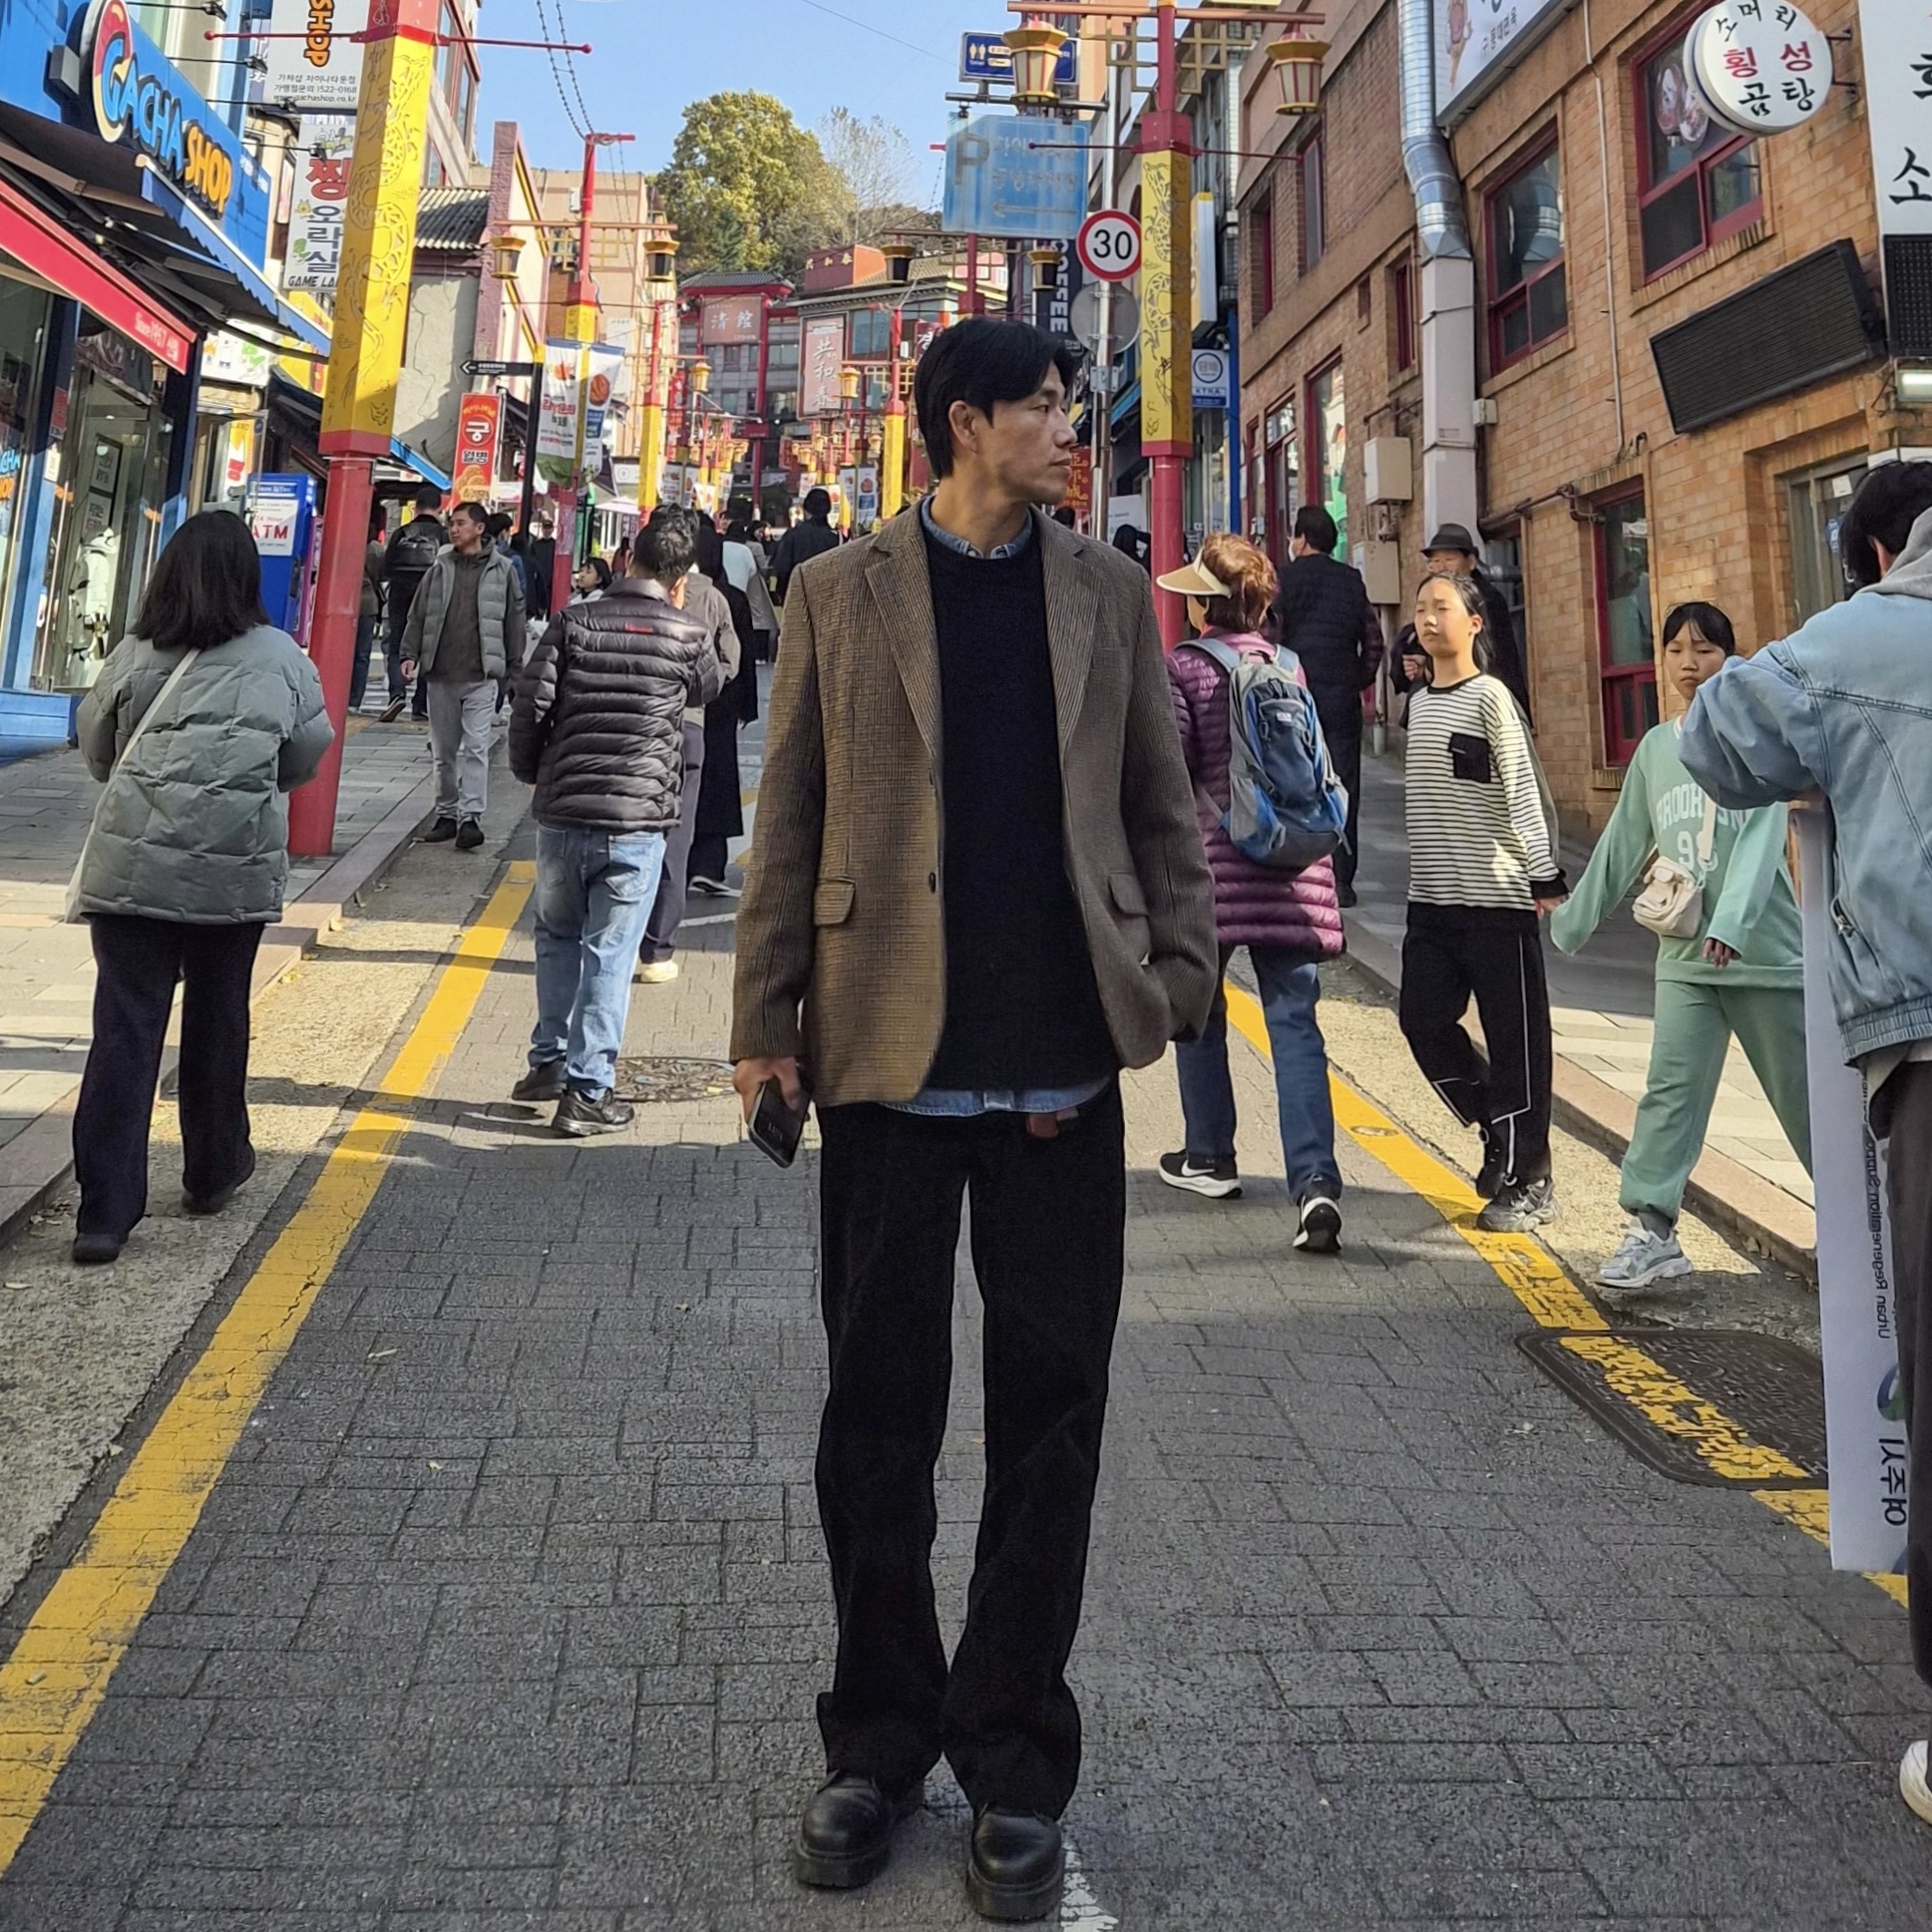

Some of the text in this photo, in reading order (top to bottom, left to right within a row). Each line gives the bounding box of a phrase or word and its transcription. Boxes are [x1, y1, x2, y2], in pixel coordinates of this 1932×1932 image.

[1716, 0, 1797, 42] 소머리
[1723, 41, 1813, 78] 횡성
[1738, 77, 1815, 117] 곰탕
[101, 33, 186, 178] GACHA
[184, 123, 233, 216] SHOP
[1093, 228, 1133, 261] 30
[288, 275, 338, 288] GAME LA
[465, 420, 491, 443] 궁
[0, 449, 21, 474] CHA
[252, 525, 288, 540] ATM
